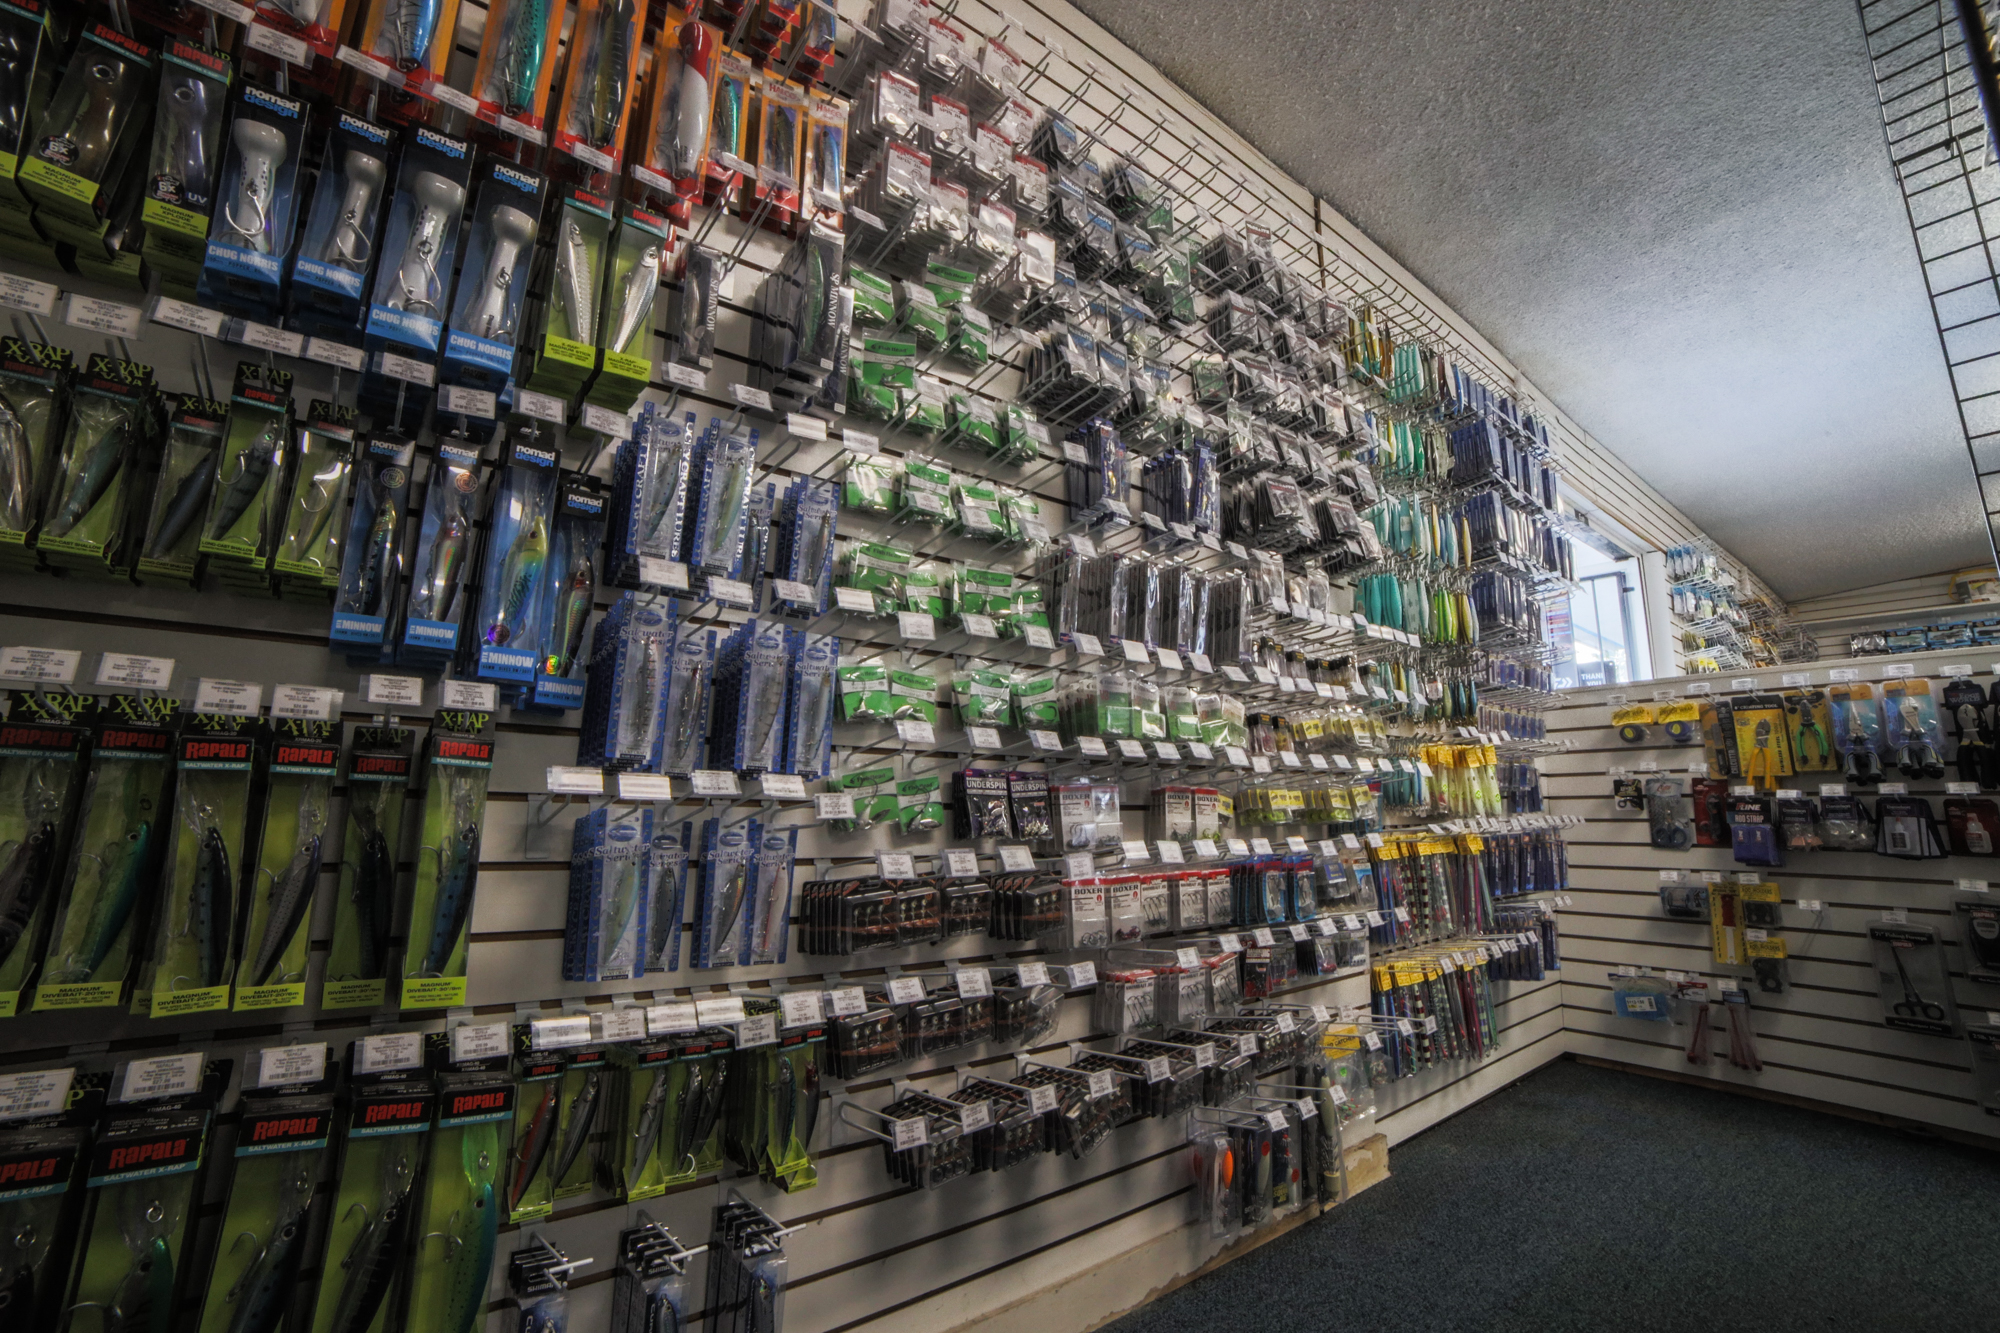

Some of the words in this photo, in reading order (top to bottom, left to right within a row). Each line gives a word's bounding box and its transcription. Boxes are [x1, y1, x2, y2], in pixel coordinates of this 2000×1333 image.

[244, 94, 298, 119] design
[245, 85, 300, 113] nomad
[338, 120, 387, 145] design
[340, 113, 390, 140] nomad
[416, 135, 465, 160] design
[418, 127, 467, 153] nomad
[493, 171, 538, 195] design
[495, 163, 540, 187] nomad
[187, 192, 207, 204] UV
[208, 245, 237, 260] CHUG
[298, 261, 324, 275] CHUG
[372, 307, 399, 324] CHUG
[827, 287, 840, 329] MINNOW
[450, 334, 475, 350] CHUG
[477, 341, 512, 360] NORRIS
[439, 450, 476, 465] design
[441, 444, 478, 458] nomad
[516, 444, 555, 460] nomad
[515, 451, 554, 468] design
[635, 453, 648, 499] CRAFT
[700, 464, 713, 513] CRAFT
[567, 499, 601, 513] design
[568, 493, 602, 507] nomad
[342, 620, 382, 633] MINNOW
[415, 625, 455, 639] MINNOW
[488, 651, 534, 668] MINNOW
[545, 681, 583, 695] MINNOW
[102, 730, 168, 748] Rapala
[186, 742, 247, 759] Rapala
[278, 746, 333, 763] Rapala
[438, 740, 489, 758] Rapala
[967, 779, 1007, 790] UNDERSPIN
[1011, 782, 1047, 791] UNDERSPIN
[1062, 793, 1091, 801] BOXER
[1167, 793, 1190, 801] BOXER
[1197, 796, 1218, 804] BOXER
[1746, 814, 1764, 823] STRAP
[1074, 887, 1103, 895] BOXER
[1113, 884, 1139, 893] BOXER
[173, 992, 211, 1000] MAGNUM
[453, 1092, 504, 1114] Rapala
[365, 1102, 422, 1123] Rapala
[253, 1117, 318, 1141] Rapala
[361, 1125, 399, 1135] SALTWATER
[109, 1139, 187, 1170] Rapala
[248, 1141, 293, 1153] SALTWATER
[104, 1167, 158, 1182] SALTWATER
